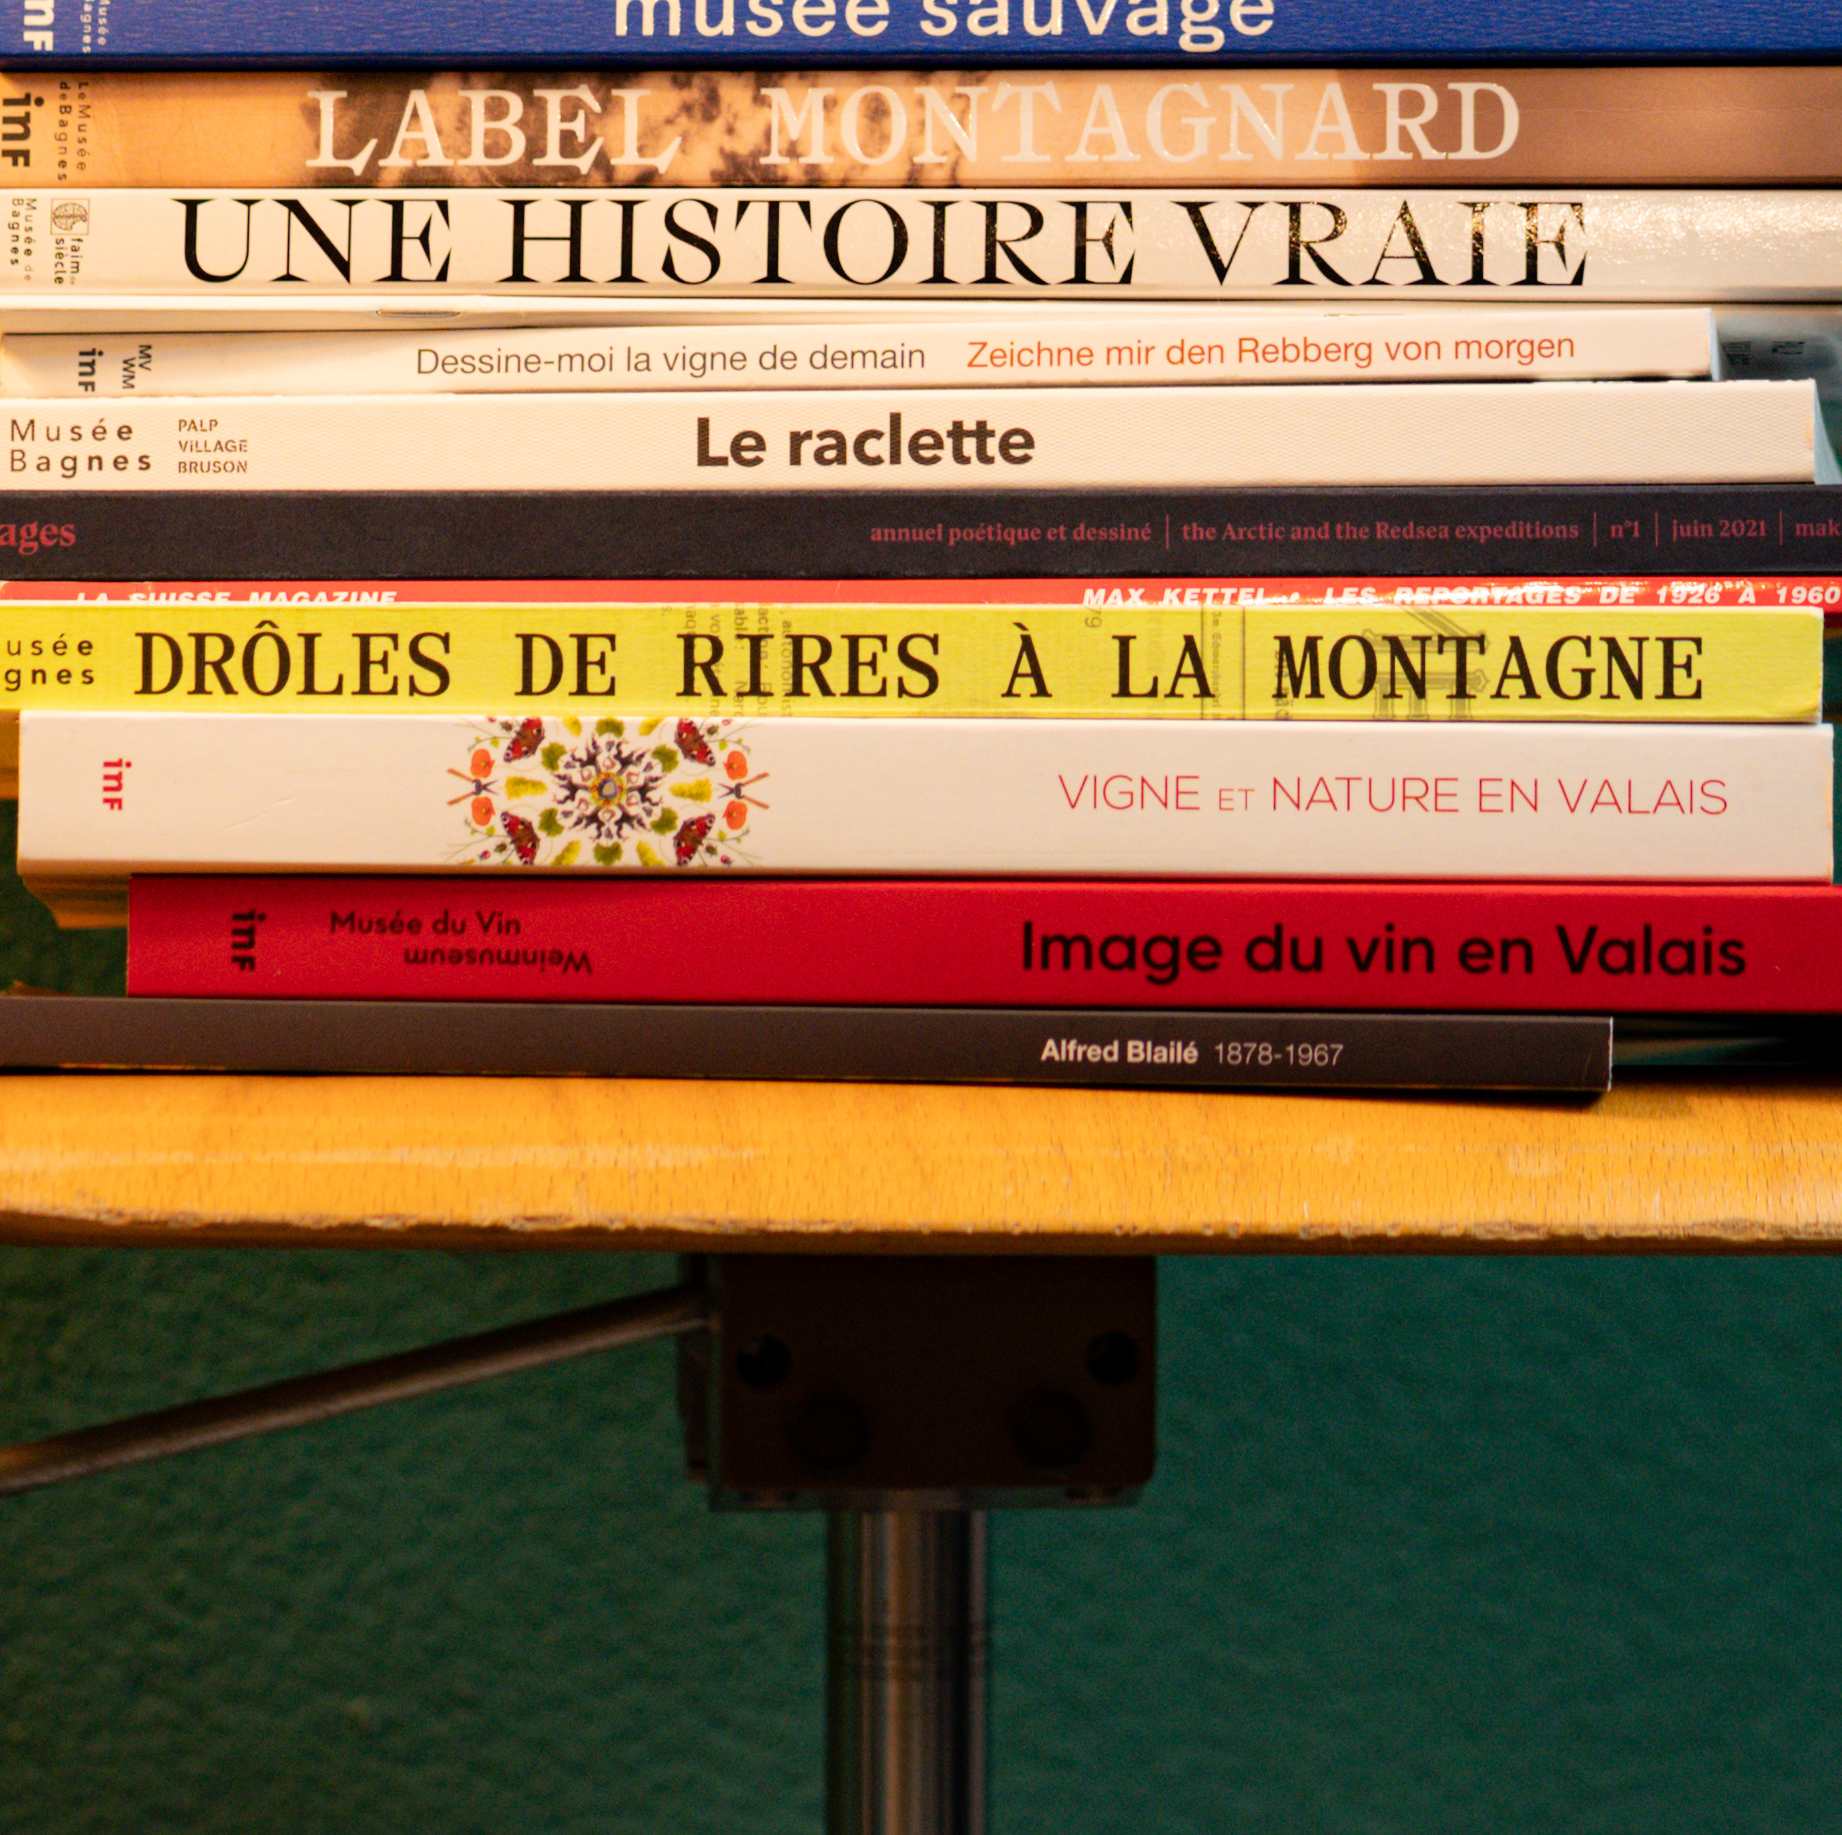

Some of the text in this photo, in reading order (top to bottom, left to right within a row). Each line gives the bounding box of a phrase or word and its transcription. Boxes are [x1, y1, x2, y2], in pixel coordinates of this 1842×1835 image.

[306, 81, 1520, 176] LABEL MONTAGNARD
[8, 198, 24, 265] Bagnes
[24, 198, 37, 281] Musée de
[169, 198, 1587, 287] UNE HISTOIRE VRAIE
[54, 238, 68, 284] siècle
[70, 238, 83, 274] faim
[122, 358, 136, 389] WM
[138, 345, 152, 371] MV
[416, 336, 1574, 378] Dessine-moi la vigne de demain Zeichne mir den Rebberg von morgen
[10, 418, 134, 442] Musée
[178, 419, 218, 432] PALP
[697, 412, 1035, 467] Le raclette
[10, 450, 152, 478] Bagnes
[178, 461, 248, 473] BRUSON
[870, 522, 942, 542] annuel
[949, 522, 1042, 546] poétique
[1047, 525, 1066, 542] et
[1073, 522, 1151, 542] dessiné
[1182, 522, 1216, 541] the
[1222, 522, 1285, 541] Arctic
[1290, 522, 1329, 541] and
[1335, 522, 1370, 541] the
[1375, 521, 1449, 540] Redsea
[1455, 520, 1578, 543] expeditions
[1671, 519, 1713, 542] juin
[1719, 519, 1766, 538] 2021
[1083, 588, 1145, 605] MAX
[1161, 587, 1266, 605] KETTEL
[1324, 587, 1376, 605] LES
[1393, 585, 1581, 605] REPORTAGES
[1600, 585, 1636, 604] DE
[1656, 585, 1720, 604] 1926
[1776, 586, 1841, 604] 1960
[134, 620, 451, 696] DRÔLES
[515, 634, 616, 697] DE
[676, 633, 939, 699] RIRES
[1001, 622, 1052, 698] À
[1111, 635, 1215, 698] LA
[1272, 633, 1703, 700] MONTAGNE
[1059, 774, 1728, 816] VIGNE ET NATURE EN VALAIS
[330, 908, 521, 935] Musée du Vin
[404, 948, 593, 975] Weinmuseum
[1022, 921, 1746, 985] Image du vin en Valais
[1041, 1038, 1344, 1066] Alfred Blailé 1878-1967
